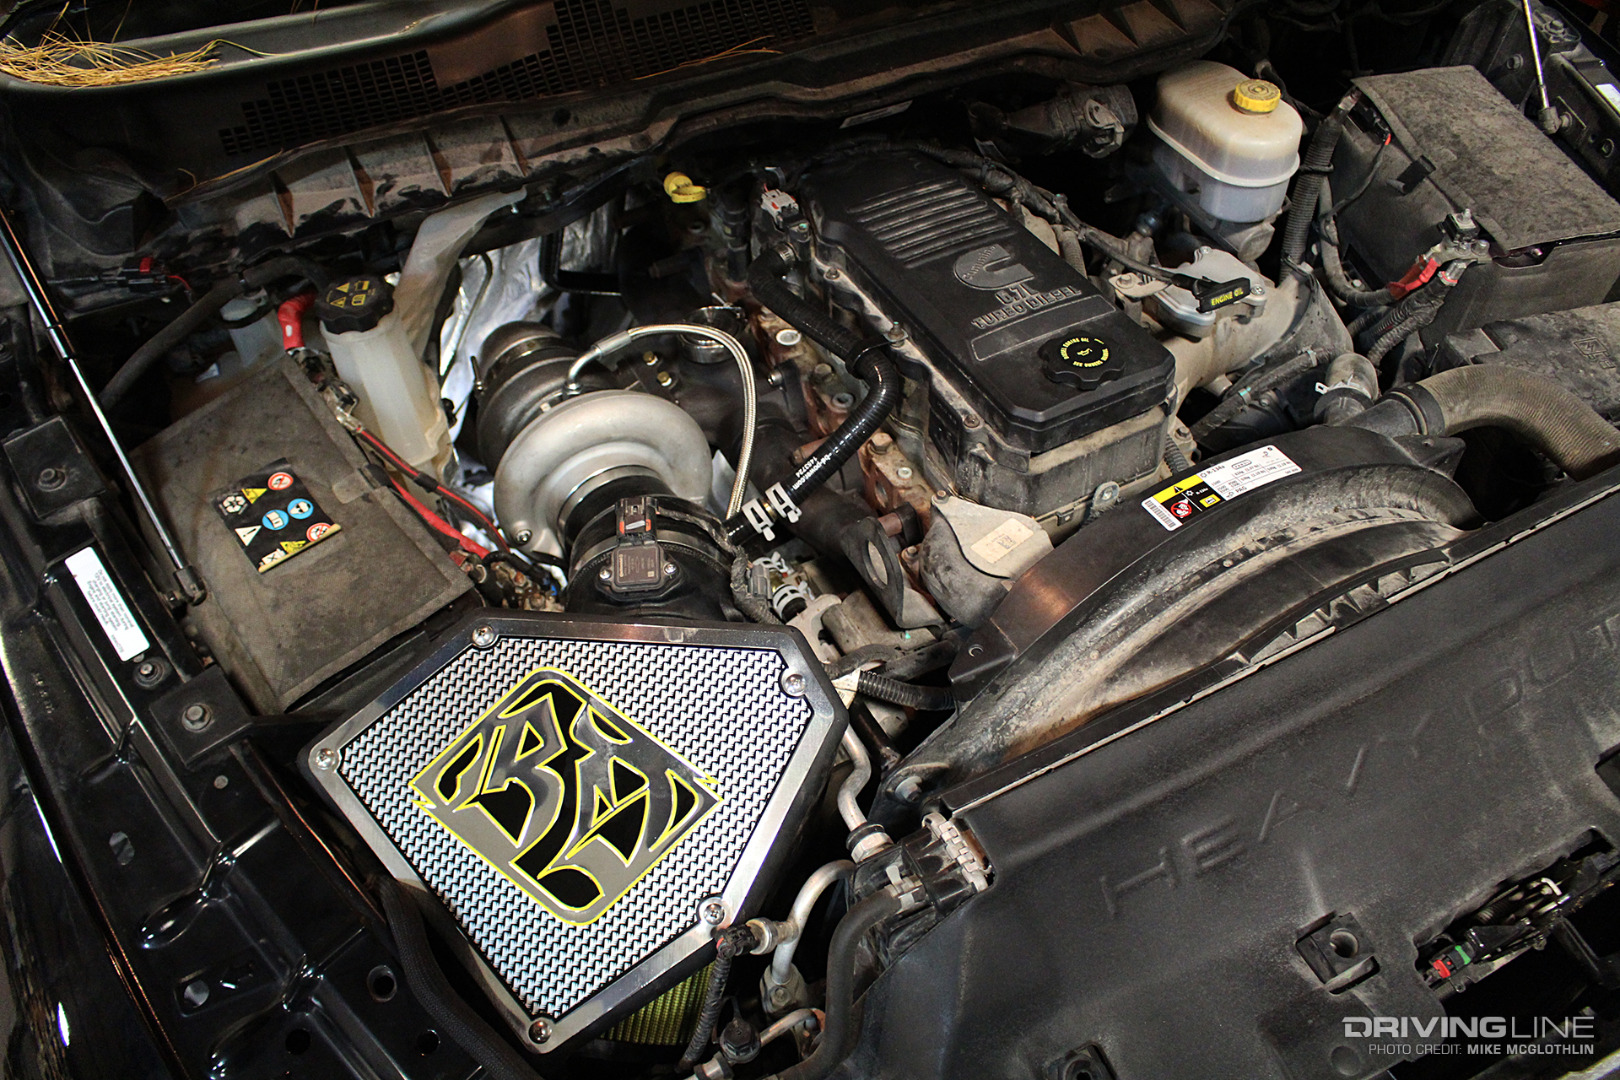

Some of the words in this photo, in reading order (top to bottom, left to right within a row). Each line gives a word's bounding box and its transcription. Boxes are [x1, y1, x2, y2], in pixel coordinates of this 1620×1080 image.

[971, 301, 1027, 329] TURBO
[1025, 285, 1082, 310] DIESEL
[995, 283, 1040, 305] 6.7L
[1211, 291, 1233, 306] ENGINE
[1233, 287, 1244, 297] OIL
[1101, 708, 1434, 917] HEAVY
